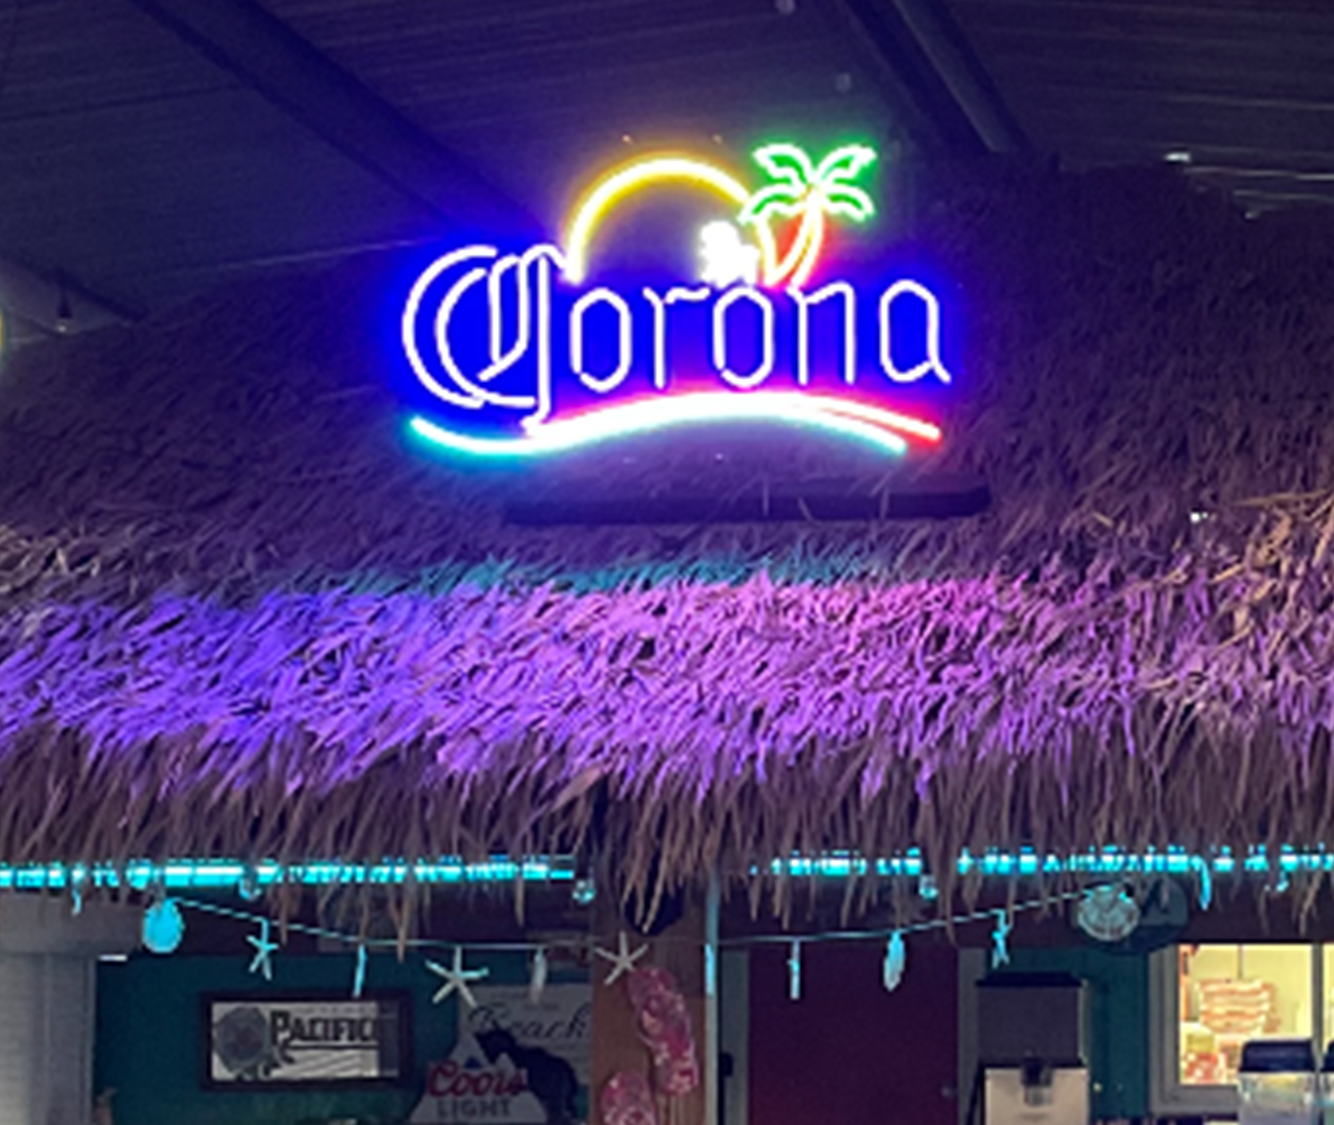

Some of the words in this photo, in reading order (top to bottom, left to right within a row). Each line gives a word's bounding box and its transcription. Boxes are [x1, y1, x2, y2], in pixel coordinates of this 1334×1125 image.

[401, 243, 951, 434] Corona
[428, 1060, 529, 1097] Coors
[437, 1099, 511, 1118] LIGHT
